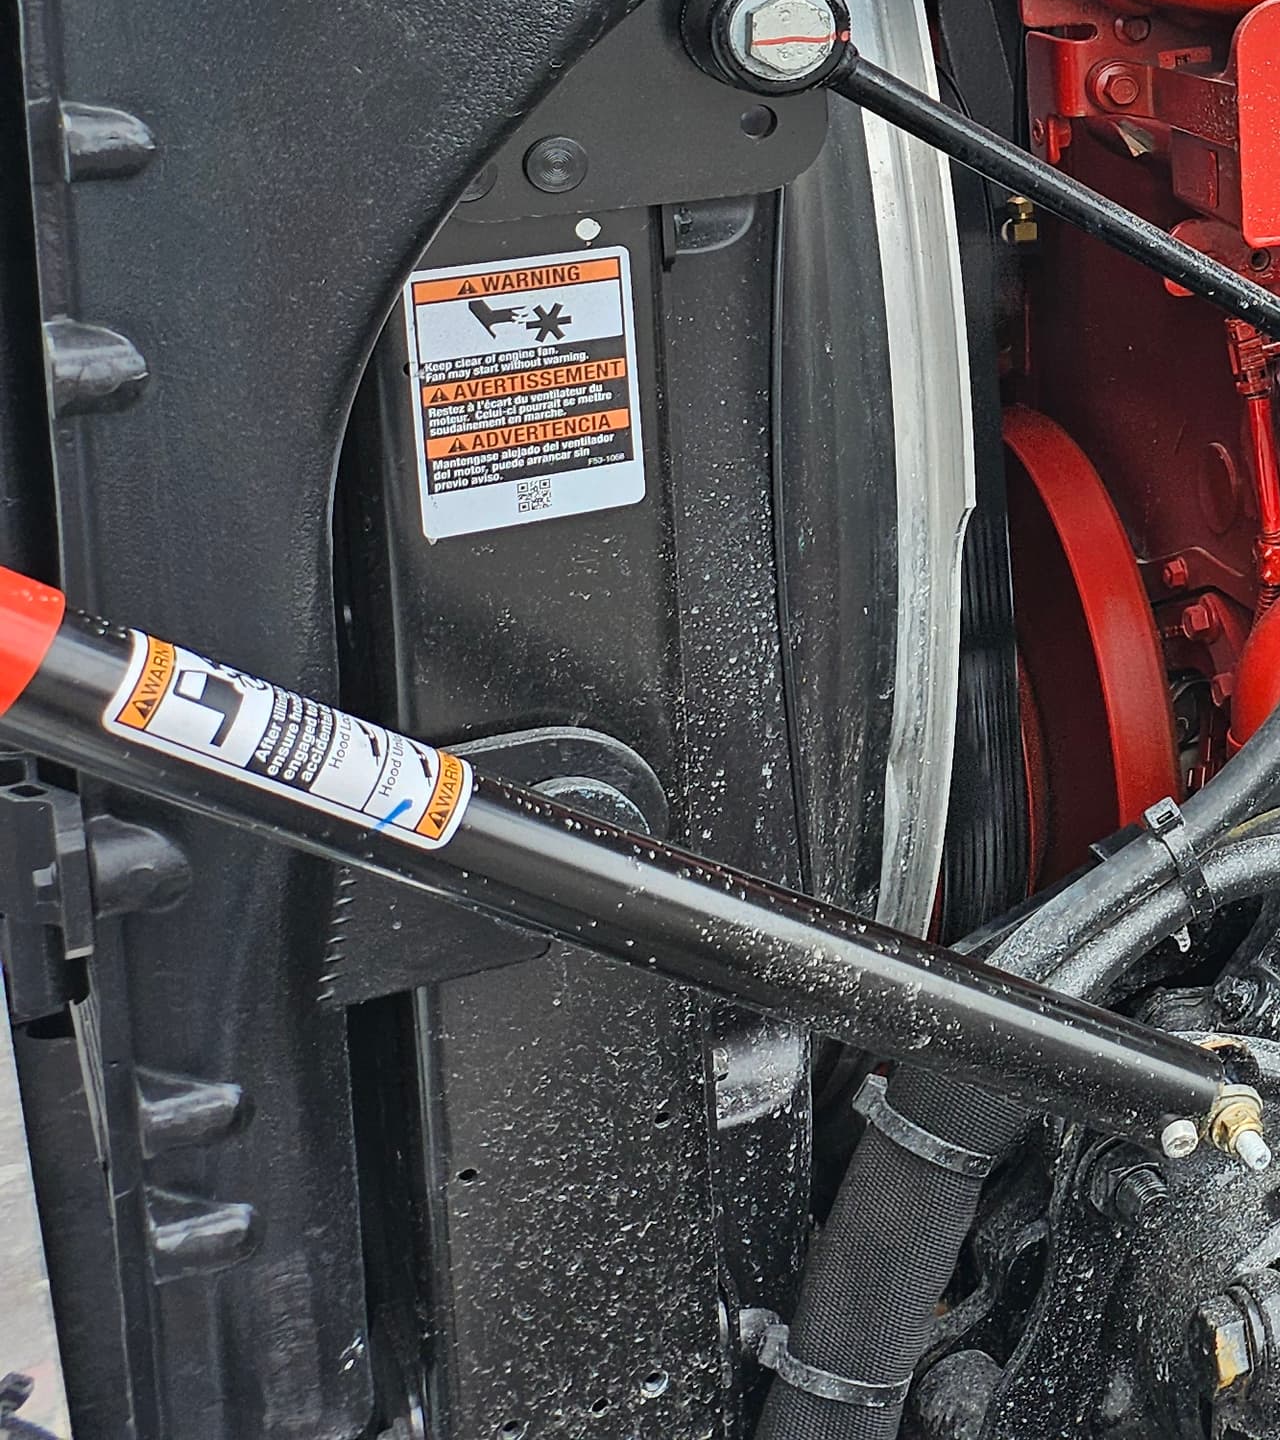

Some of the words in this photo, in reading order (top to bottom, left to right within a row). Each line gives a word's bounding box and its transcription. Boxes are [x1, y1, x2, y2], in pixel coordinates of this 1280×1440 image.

[481, 266, 581, 292] WARNING
[424, 361, 453, 374] Keep
[455, 356, 482, 368] clear
[485, 354, 496, 364] of
[498, 349, 535, 363] engine
[537, 347, 558, 357] fan.
[425, 371, 445, 383] Fan
[448, 368, 470, 382] may
[473, 364, 499, 375] start
[501, 358, 541, 372] without
[543, 351, 589, 367] warning.
[453, 361, 622, 401] AVERTISSEMENT
[428, 404, 465, 418] Restez
[514, 394, 529, 406] du
[530, 387, 587, 403] ventilateur
[589, 383, 603, 393] du
[429, 415, 470, 428] moteur.
[518, 399, 561, 414] pourrait
[563, 397, 575, 407] se
[577, 391, 612, 405] mettre
[430, 418, 506, 437] soudainement
[508, 415, 522, 425] en
[524, 408, 567, 422] marche.
[471, 414, 612, 450] ADVERTENCIA
[432, 453, 499, 471] Mantengase
[501, 445, 540, 460] alejado
[543, 441, 560, 453] del
[561, 433, 615, 449] ventilador
[433, 470, 451, 482] del
[492, 460, 525, 473] puede
[527, 452, 572, 466] arrancar
[574, 448, 590, 458] sin
[434, 480, 468, 493] previo
[471, 475, 503, 487] aviso.
[141, 642, 169, 695] WARN
[255, 727, 282, 765] After
[267, 720, 299, 778] ensure
[282, 716, 317, 781] engaged
[331, 737, 351, 771] Hood
[379, 759, 402, 799] Hood
[437, 755, 460, 816] WARN
